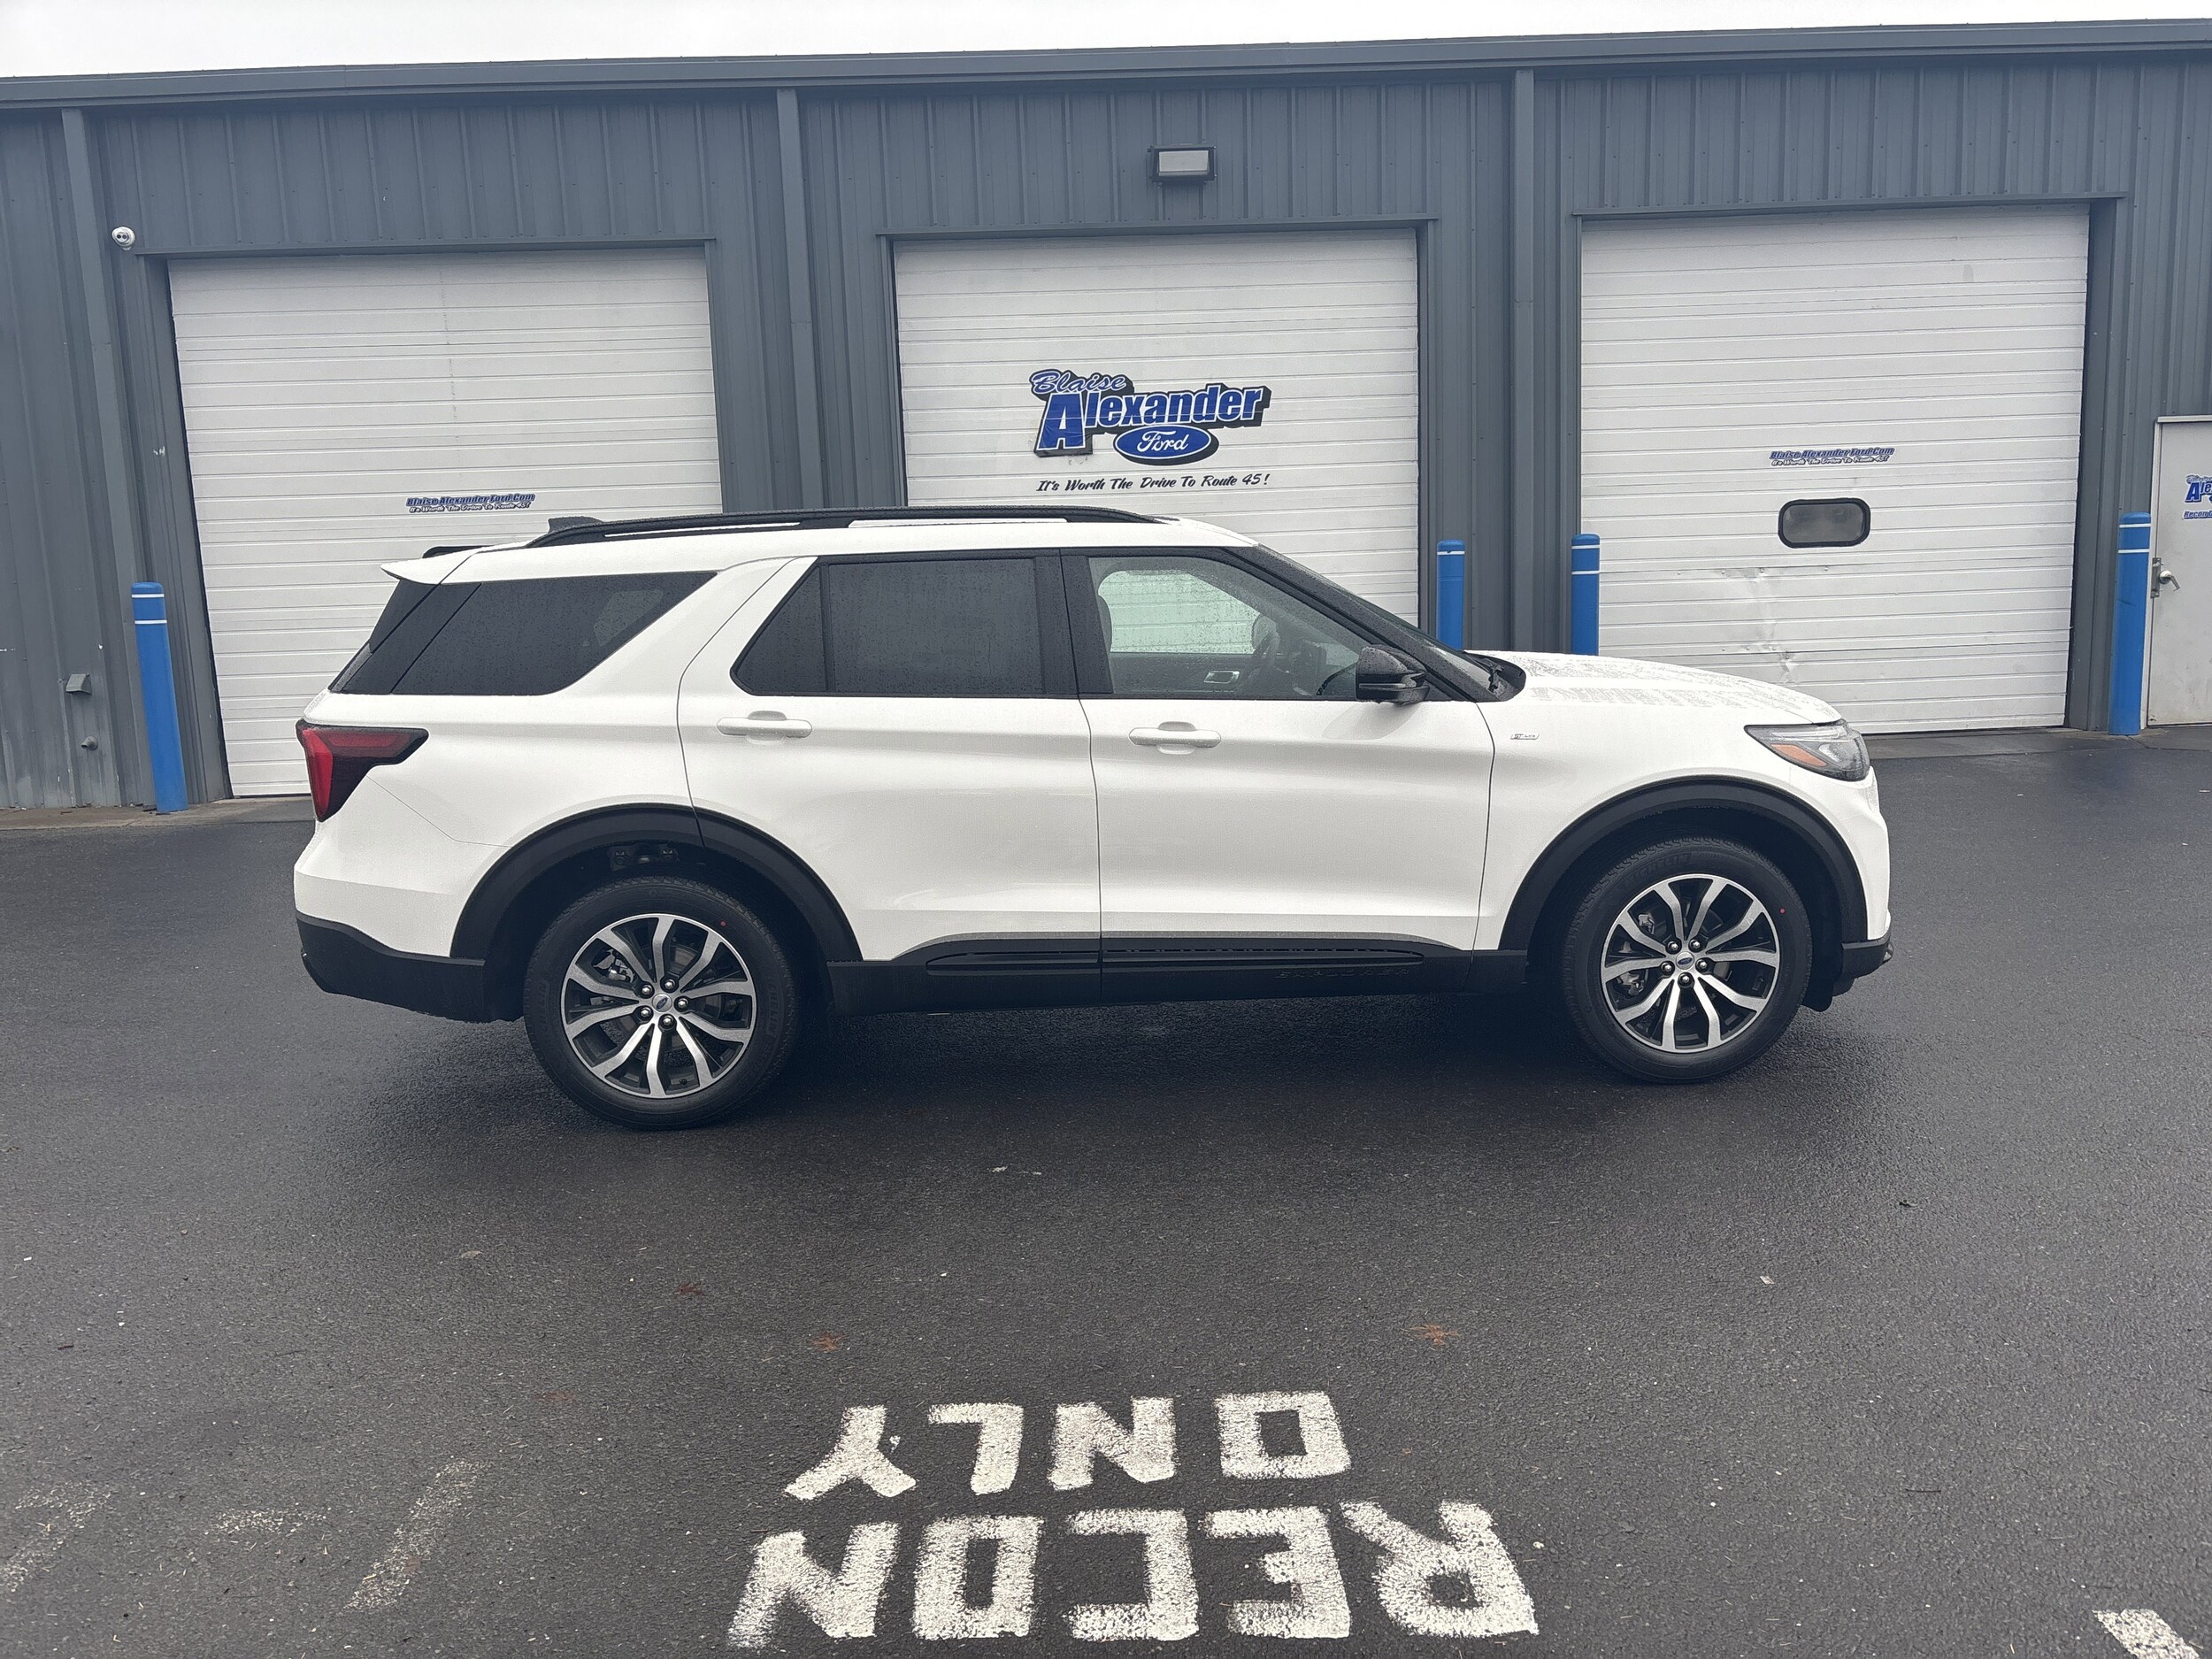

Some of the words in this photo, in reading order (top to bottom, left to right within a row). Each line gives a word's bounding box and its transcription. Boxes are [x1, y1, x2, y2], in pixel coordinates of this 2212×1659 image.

[1031, 370, 1126, 395] Blaise
[1035, 384, 1266, 452] Alexander
[1136, 428, 1190, 453] Ford
[1770, 450, 1801, 459] Blaise
[1035, 480, 1060, 492] It's
[1064, 478, 1105, 491] Worth
[1110, 478, 1133, 490] The
[1140, 476, 1177, 488] Drive
[1180, 475, 1196, 488] To
[1201, 474, 1238, 488] Route
[406, 496, 439, 506] Blaise
[784, 1390, 1352, 1500] ONLY
[727, 1501, 1540, 1648] RECON
